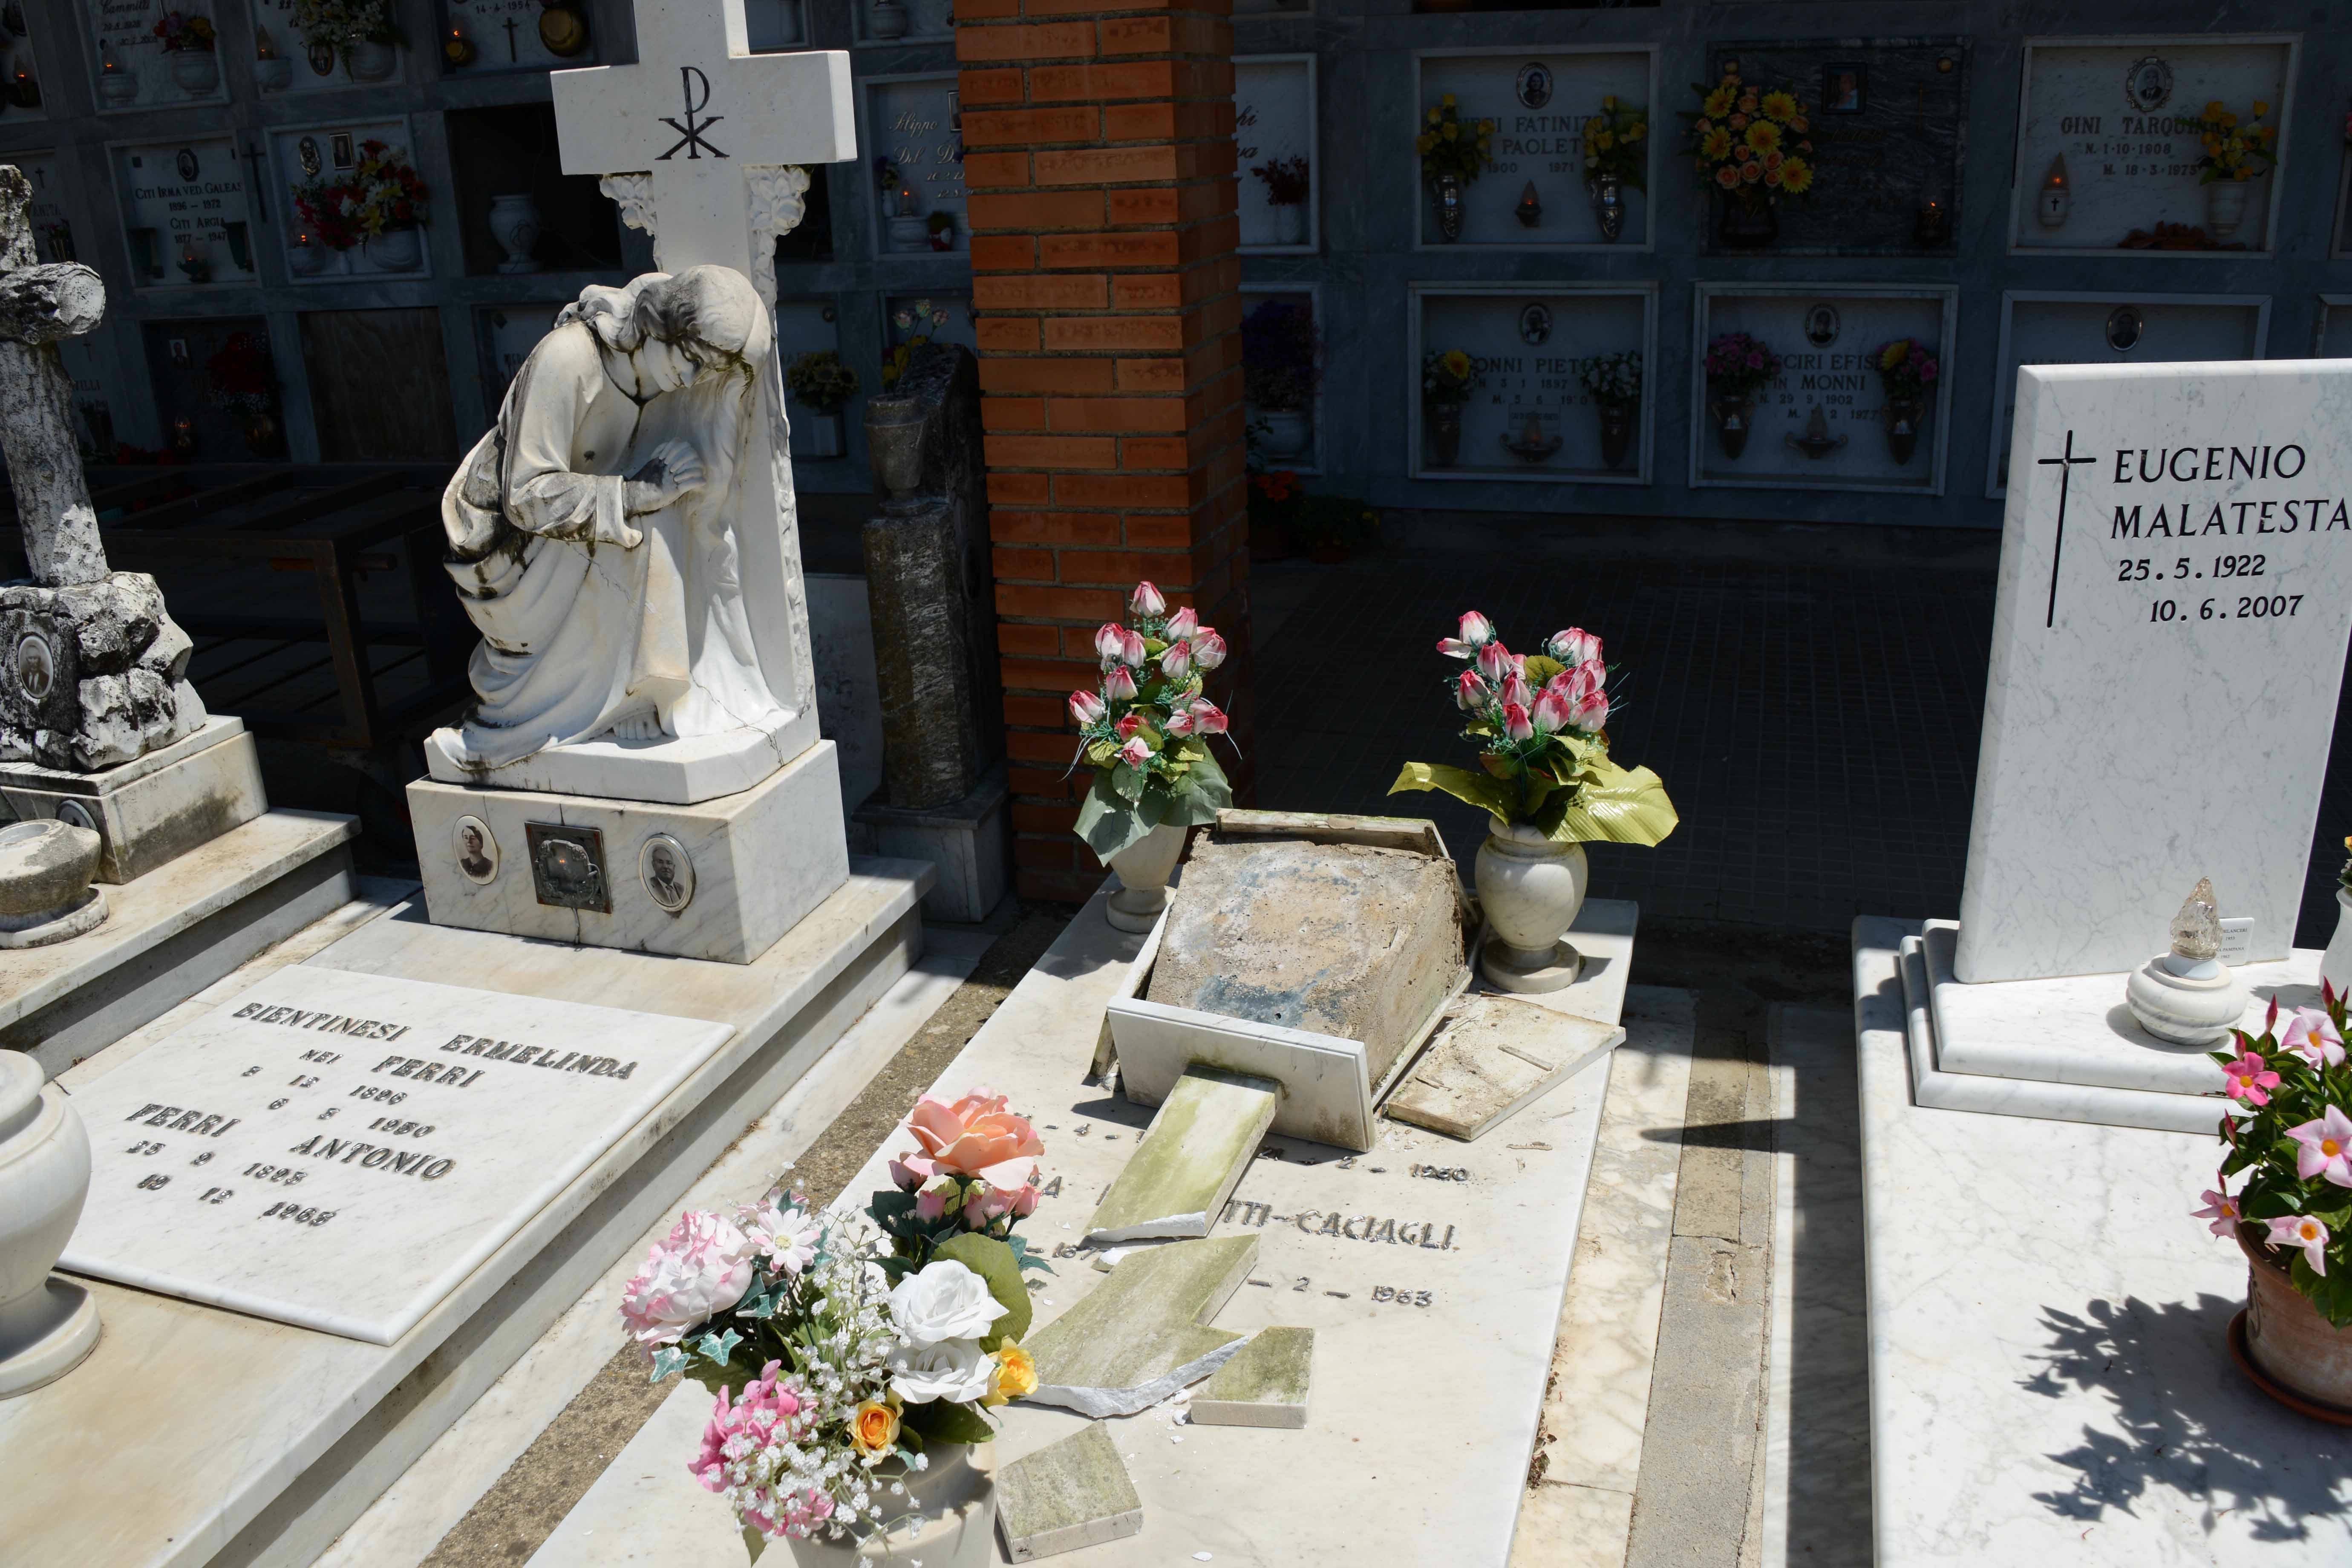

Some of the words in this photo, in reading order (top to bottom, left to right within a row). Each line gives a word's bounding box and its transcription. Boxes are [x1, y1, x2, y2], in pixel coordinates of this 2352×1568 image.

[2061, 116, 2102, 135] GINI
[1502, 138, 1582, 155] PAOLET
[1548, 162, 1575, 173] 1971
[1473, 357, 1524, 374] ONNI
[1800, 375, 1865, 390] MONNI
[2113, 444, 2306, 484] EUGENIO
[2110, 497, 2352, 539] MALATESTA
[232, 1002, 412, 1041] BIENTINESI
[439, 1034, 638, 1080] ERMELINDA
[371, 1055, 486, 1087] FERRI
[349, 1085, 408, 1105] 1896
[124, 1103, 241, 1137] FERRI
[289, 1135, 456, 1181] ANTONIO
[242, 1162, 307, 1186] 1895
[1223, 1199, 1455, 1250] TTI-CACIAGLI
[1371, 1285, 1432, 1308] 1963
